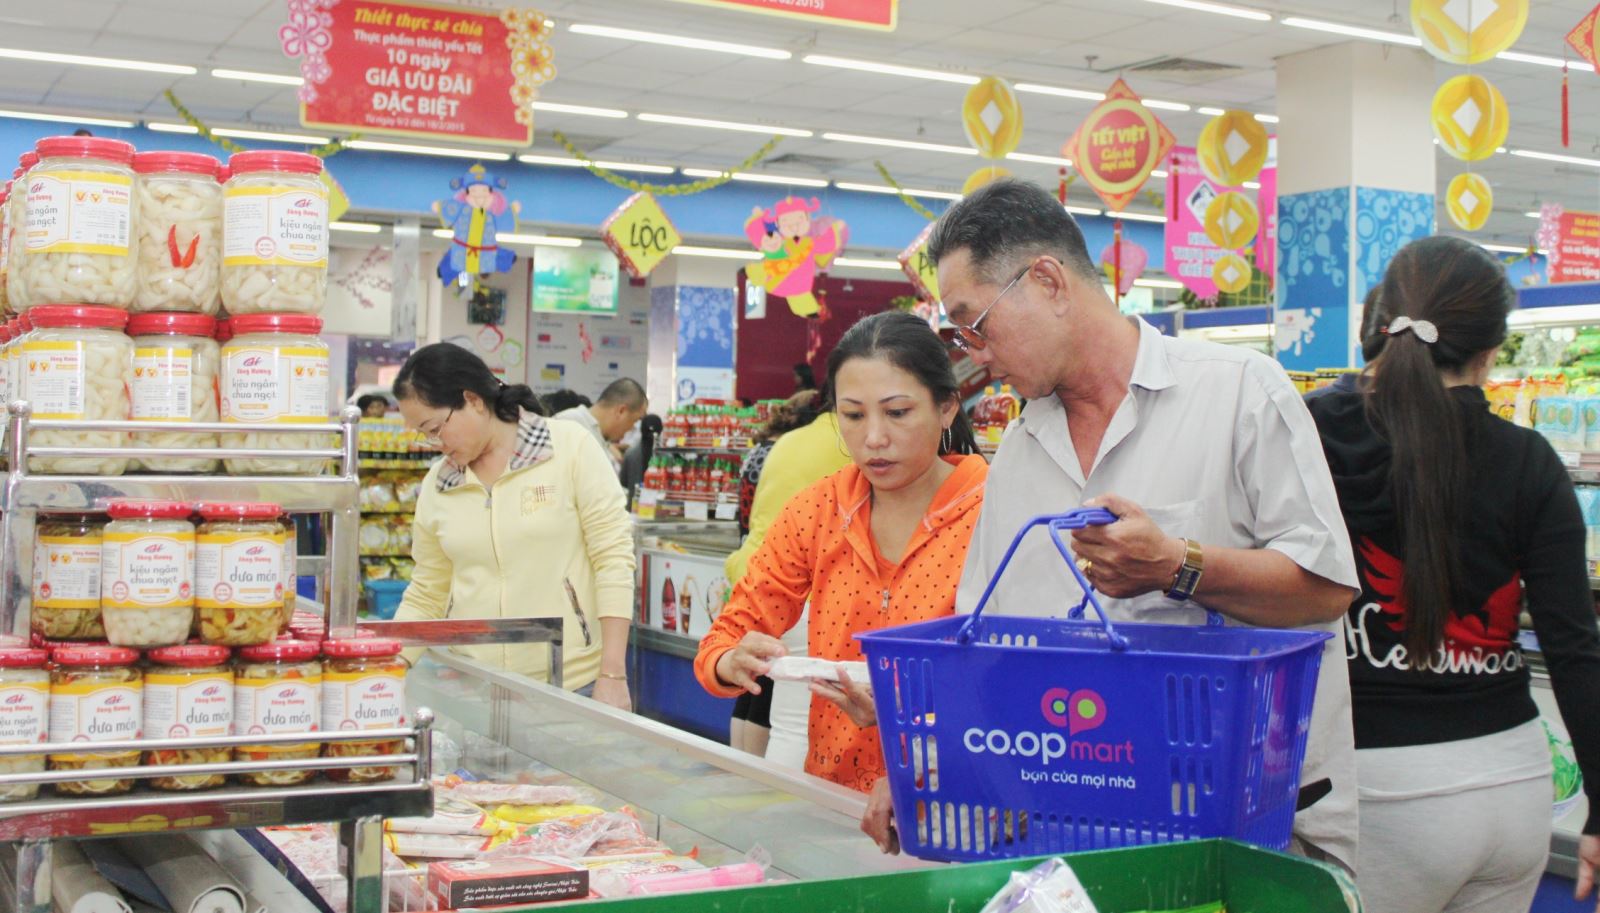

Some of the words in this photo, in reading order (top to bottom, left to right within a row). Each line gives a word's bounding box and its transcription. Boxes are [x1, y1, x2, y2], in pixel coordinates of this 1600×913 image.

[355, 8, 393, 26] Thiết
[395, 13, 430, 32] thực
[452, 19, 484, 36] chia
[353, 29, 381, 44] Thực
[387, 48, 407, 65] 10
[410, 52, 451, 72] ngày
[365, 66, 400, 88] GIÁ
[404, 70, 434, 91] ƯU
[438, 73, 473, 95] ĐÃI
[372, 90, 414, 116] ĐẶC
[418, 95, 460, 120] BIỆT
[1092, 126, 1115, 146] TẾT
[1117, 123, 1146, 144] VIỆT
[630, 218, 667, 256] LỘC
[230, 566, 253, 582] dưa
[186, 707, 209, 724] dưa
[263, 708, 286, 725] dưa
[290, 711, 311, 724] món
[354, 703, 377, 719] dưa
[88, 716, 113, 734] dưa
[1021, 768, 1048, 784] bạn
[1052, 770, 1078, 784] của
[1081, 774, 1105, 789] mọi
[1109, 775, 1136, 789] nhà
